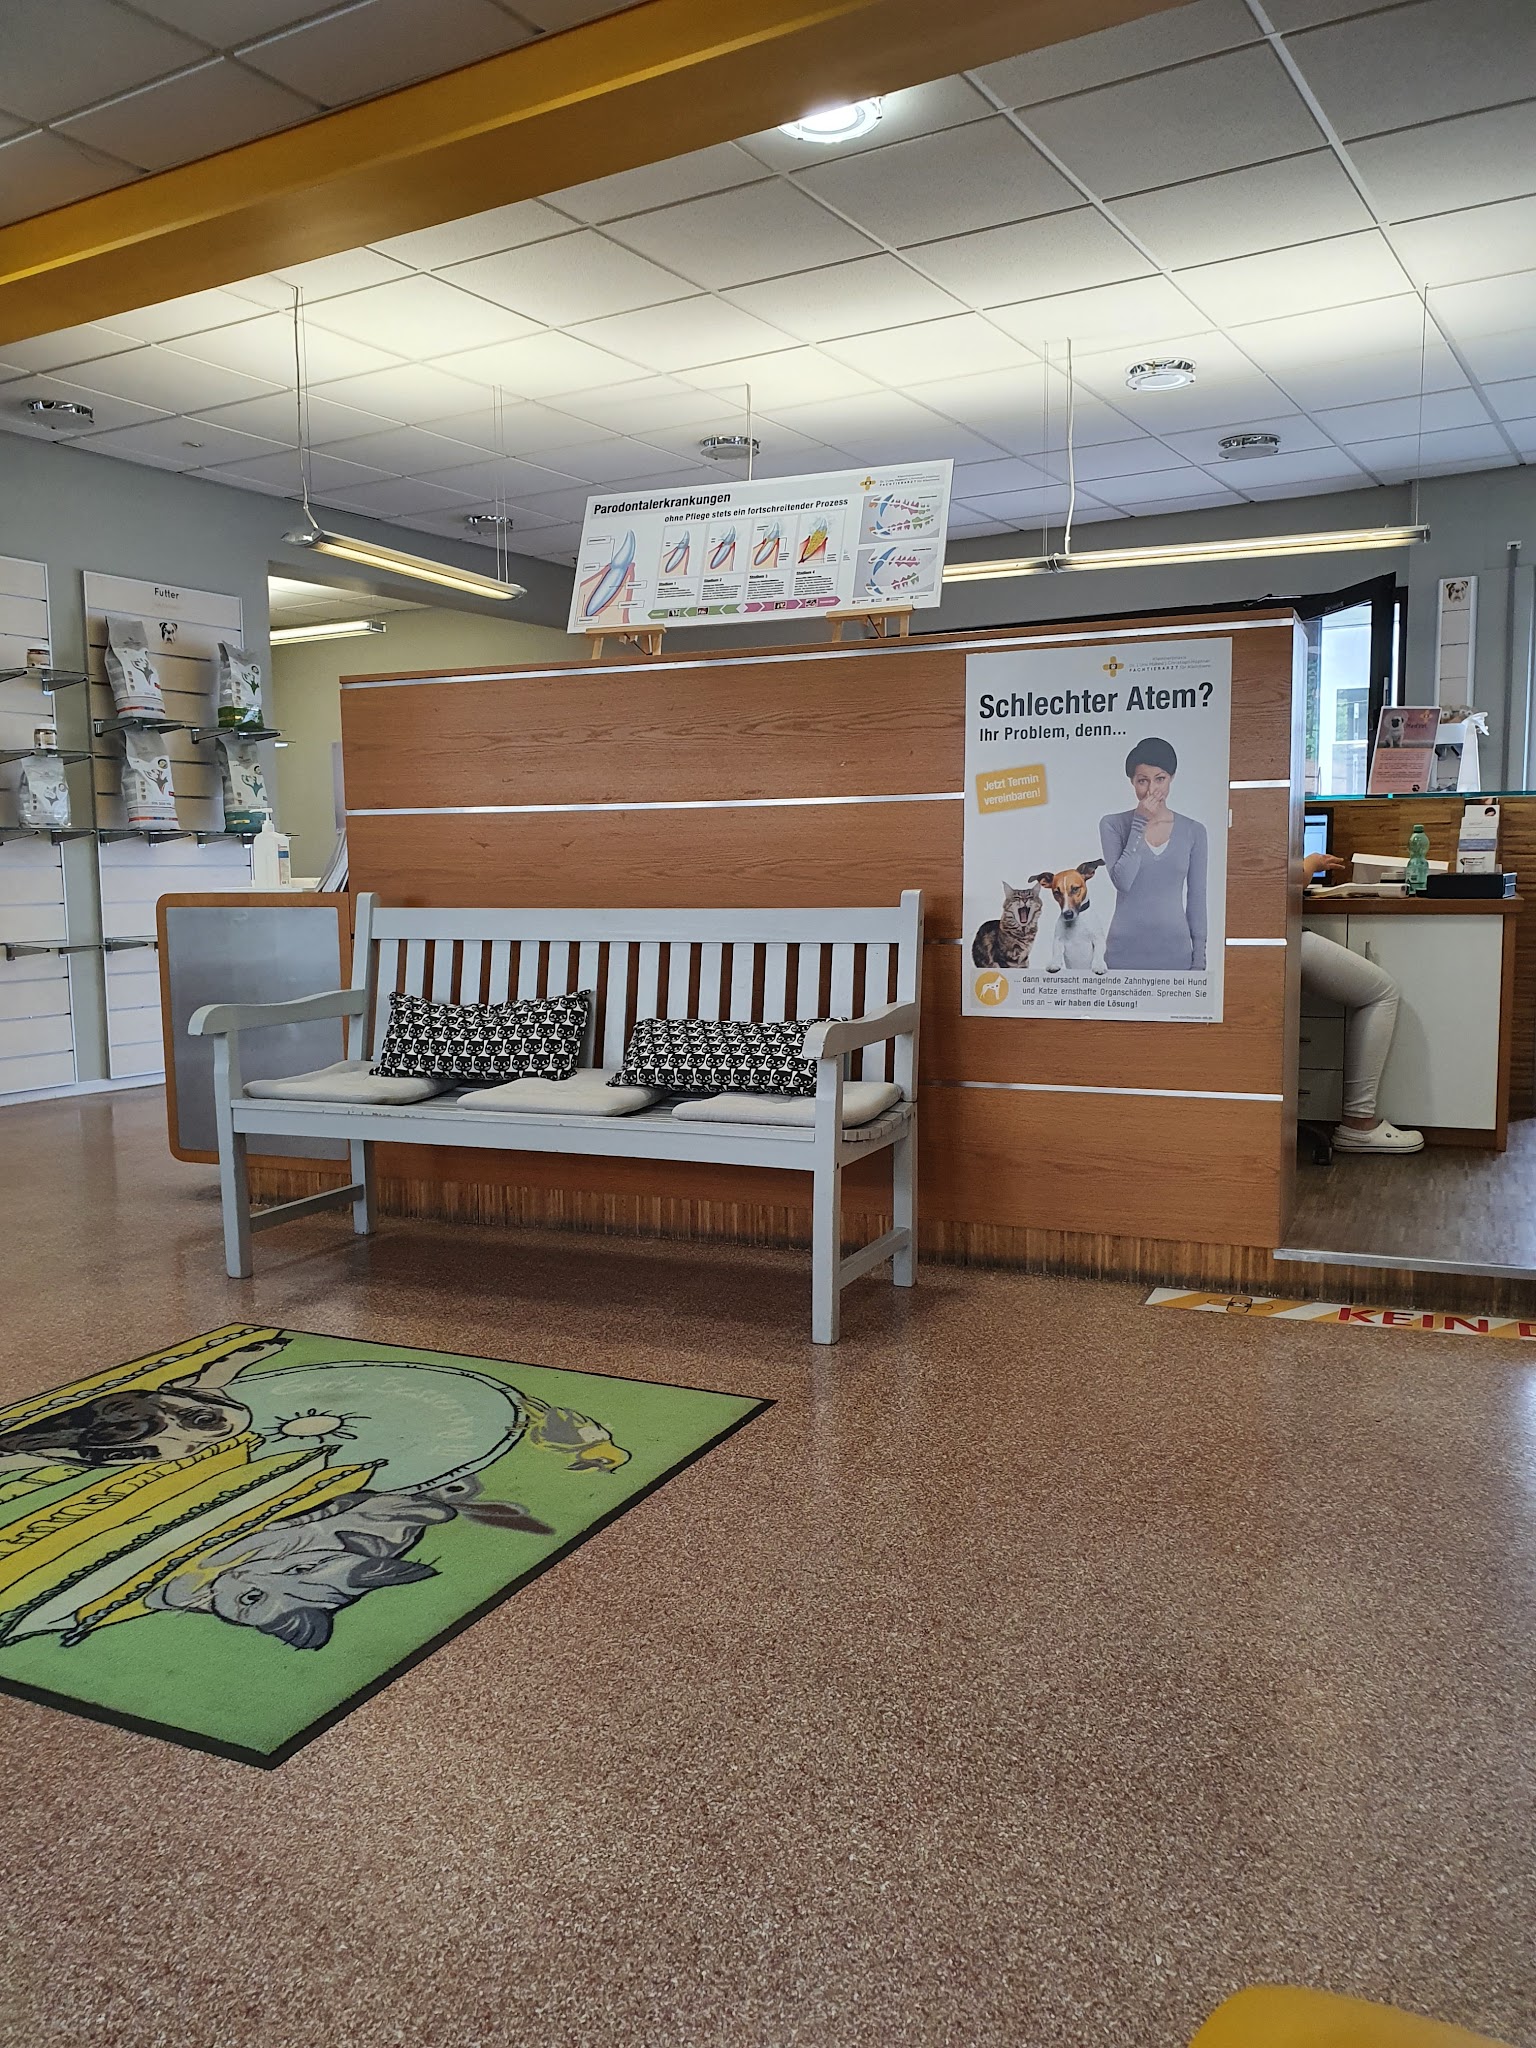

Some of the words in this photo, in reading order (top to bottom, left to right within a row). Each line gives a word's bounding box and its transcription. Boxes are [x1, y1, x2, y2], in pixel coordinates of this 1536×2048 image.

[594, 493, 731, 515] Parodontalerkrankungen
[664, 515, 684, 523] ohne
[685, 511, 710, 521] Pflege
[711, 510, 732, 519] stets
[733, 508, 746, 516] ein
[747, 501, 814, 515] fortschreitender
[815, 498, 849, 508] Prozess
[154, 587, 180, 599] Futter
[979, 689, 1118, 719] Schlechter
[1125, 682, 1214, 711] Atem?
[979, 728, 1000, 742] Ihr
[1004, 725, 1070, 741] Problem,
[1075, 723, 1127, 737] denn...
[983, 779, 1006, 791] Jetzt
[1007, 774, 1039, 787] Termin
[984, 787, 1041, 805] vereinbaren!
[1042, 976, 1080, 984] verursacht
[1082, 976, 1121, 985] mangelnde
[1124, 977, 1171, 987] Zahnhygiene
[1173, 977, 1185, 986] bei
[1187, 978, 1208, 986] Hund
[1038, 987, 1058, 995] Katze
[1060, 987, 1097, 996] ernsthafte
[1100, 988, 1154, 997] Organschäden.
[1156, 989, 1192, 998] Sprechen
[1194, 989, 1208, 997] Sie
[1068, 999, 1092, 1007] haben
[1093, 999, 1106, 1007] die
[1107, 999, 1138, 1009] Lösung!
[1337, 1307, 1489, 1333] KEIN
